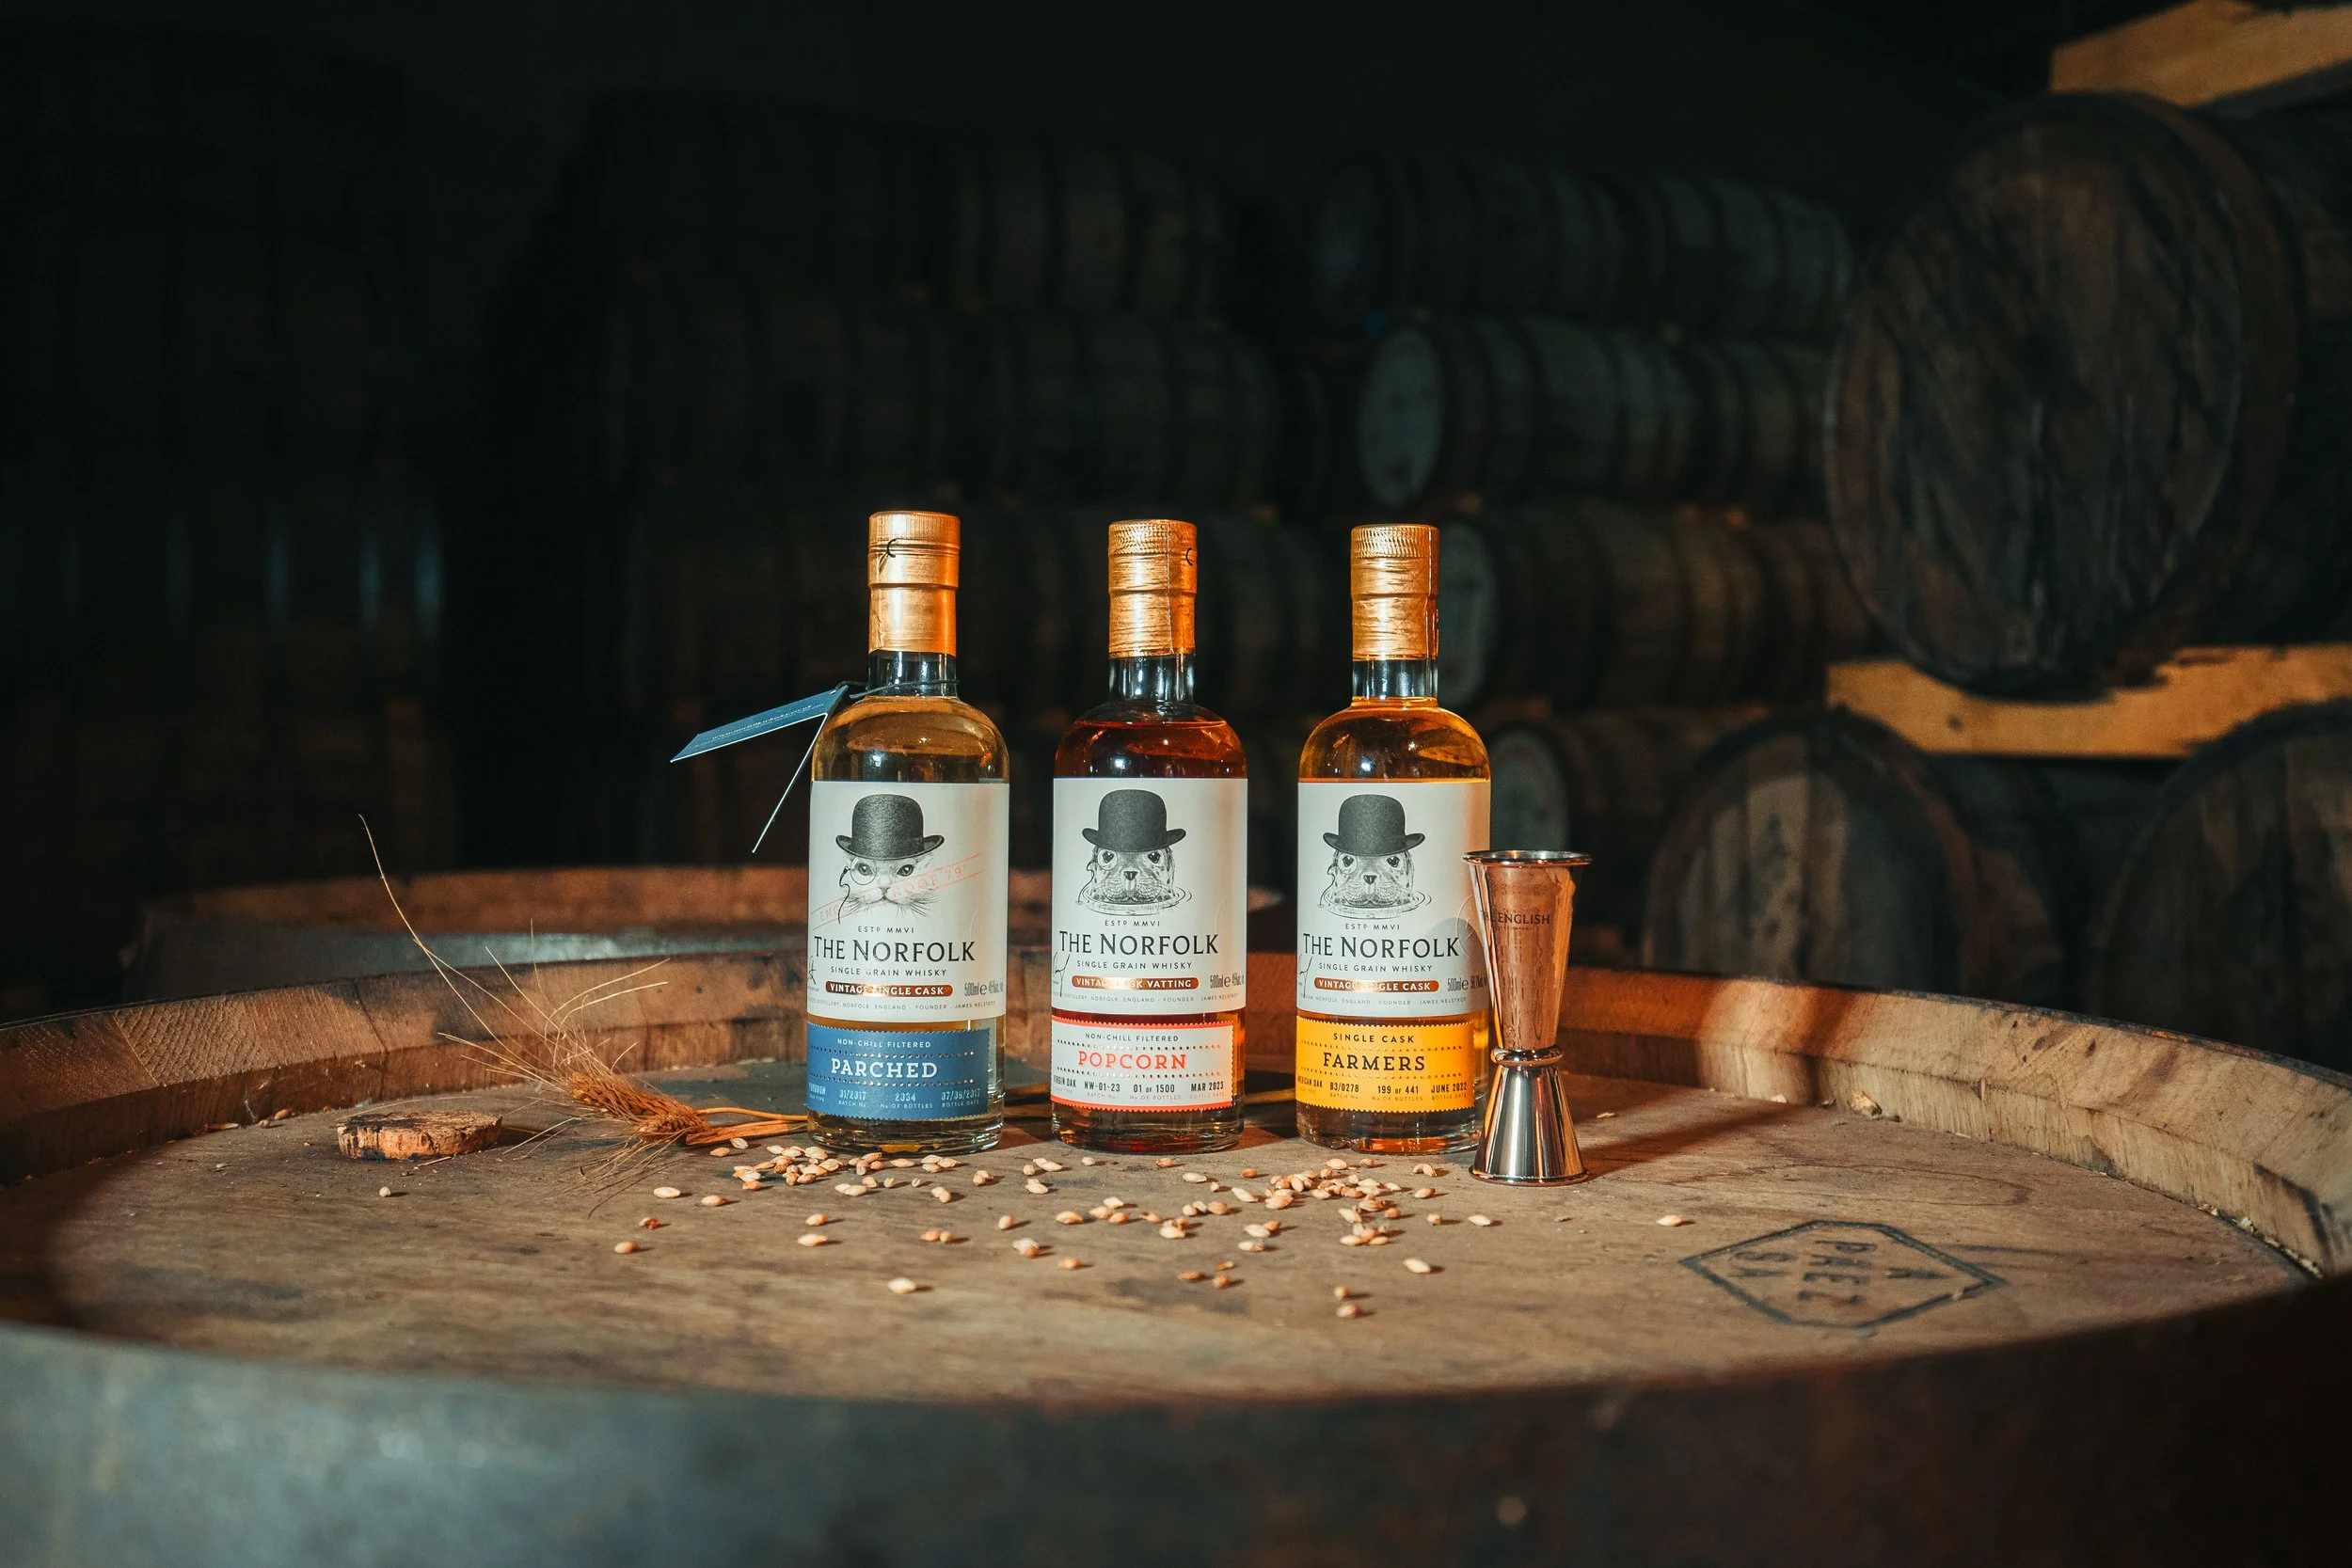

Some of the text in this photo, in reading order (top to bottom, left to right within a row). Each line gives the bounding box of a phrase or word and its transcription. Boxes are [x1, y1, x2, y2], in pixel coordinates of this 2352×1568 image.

[1497, 911, 1551, 925] ENGLISH
[814, 935, 976, 963] THE NORFOLK
[1059, 930, 1219, 956] THE NORFOLK
[1303, 933, 1460, 958] THE NORFOLK
[830, 965, 947, 977] SINGLE GRAIN WHISKY
[1076, 959, 1193, 970] SINGLE GRAIN WHISKY
[1319, 962, 1433, 973] SINGLE GRAIN WHISKY
[1075, 977, 1192, 988] VINTAG SK VATTING
[1318, 979, 1431, 991] VINTAGE NGLE CASK
[829, 983, 868, 996] VINTAGE
[874, 983, 911, 996] NGLE
[914, 986, 945, 996] CASK
[837, 1037, 883, 1048] NON-CHILL
[1085, 1033, 1131, 1042] NON-CHILL
[1333, 1032, 1414, 1043] SINGLE CASK
[1078, 1051, 1187, 1069] POPCORN
[1323, 1052, 1425, 1071] FARMERS
[831, 1057, 938, 1079] PARCHED
[1066, 1078, 1076, 1087] OAK
[1084, 1081, 1120, 1092] NW-01-23
[1133, 1084, 1142, 1093] 01
[1155, 1084, 1175, 1093] 1500
[1190, 1082, 1206, 1092] MAR
[1208, 1081, 1224, 1091] 2023
[1313, 1079, 1323, 1088] OAK
[1377, 1085, 1391, 1095] 199
[1405, 1085, 1419, 1094] 441
[1430, 1084, 1450, 1094] JUNE
[1452, 1081, 1468, 1092] 2022
